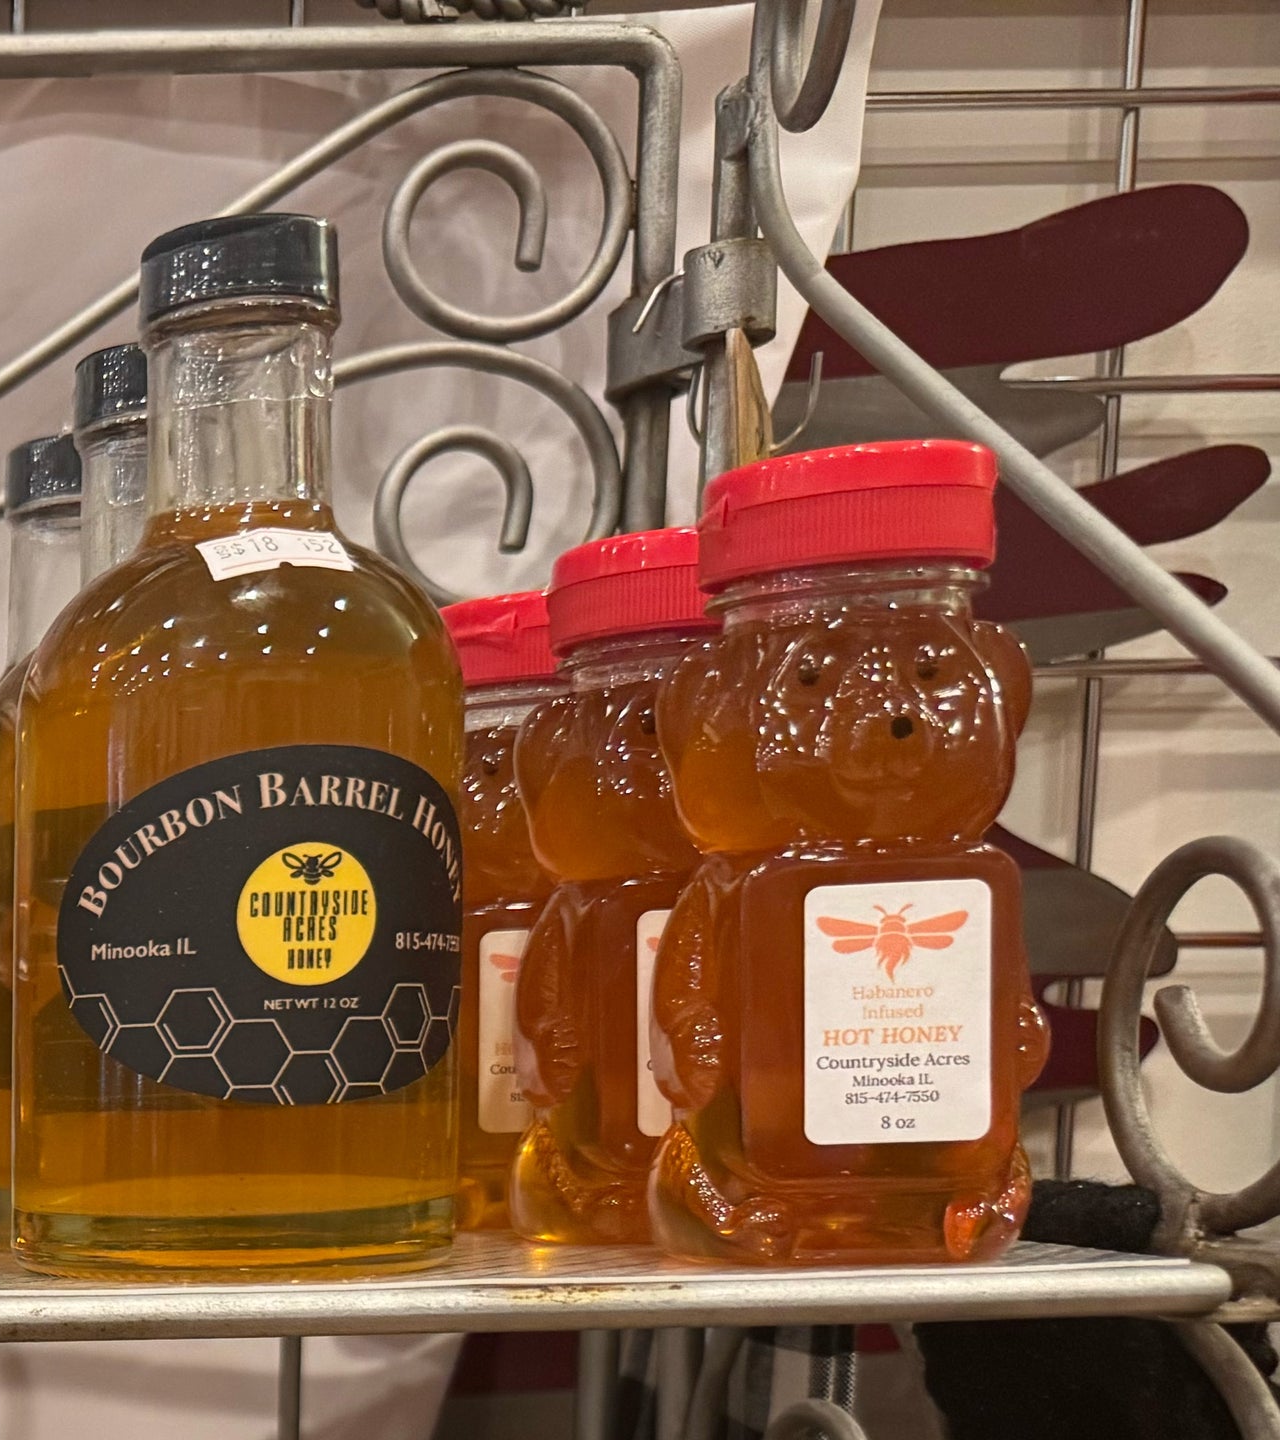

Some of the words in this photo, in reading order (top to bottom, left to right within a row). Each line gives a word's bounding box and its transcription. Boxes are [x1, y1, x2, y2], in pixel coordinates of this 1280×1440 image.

[76, 784, 243, 918] BOURBON
[257, 772, 404, 820] BARREL
[250, 890, 368, 917] COUNTRYSIDE
[283, 916, 337, 942] ACRES
[91, 942, 170, 960] Minooka
[176, 938, 196, 956] IL
[287, 948, 332, 970] HONEY
[852, 984, 934, 1000] Habanero
[264, 998, 293, 1010] NET
[295, 998, 320, 1009] WT
[324, 998, 337, 1009] 12
[339, 997, 359, 1009] OZ
[862, 1003, 923, 1020] Infused
[822, 1028, 874, 1047] HOT
[882, 1025, 963, 1045] HONEY
[816, 1053, 919, 1072] Countryside
[925, 1052, 971, 1067] Acres
[852, 1073, 914, 1087] Minooka
[918, 1073, 934, 1086] IL
[844, 1090, 940, 1105] 815-474-7550
[881, 1115, 891, 1129] 8
[896, 1117, 916, 1129] oz
